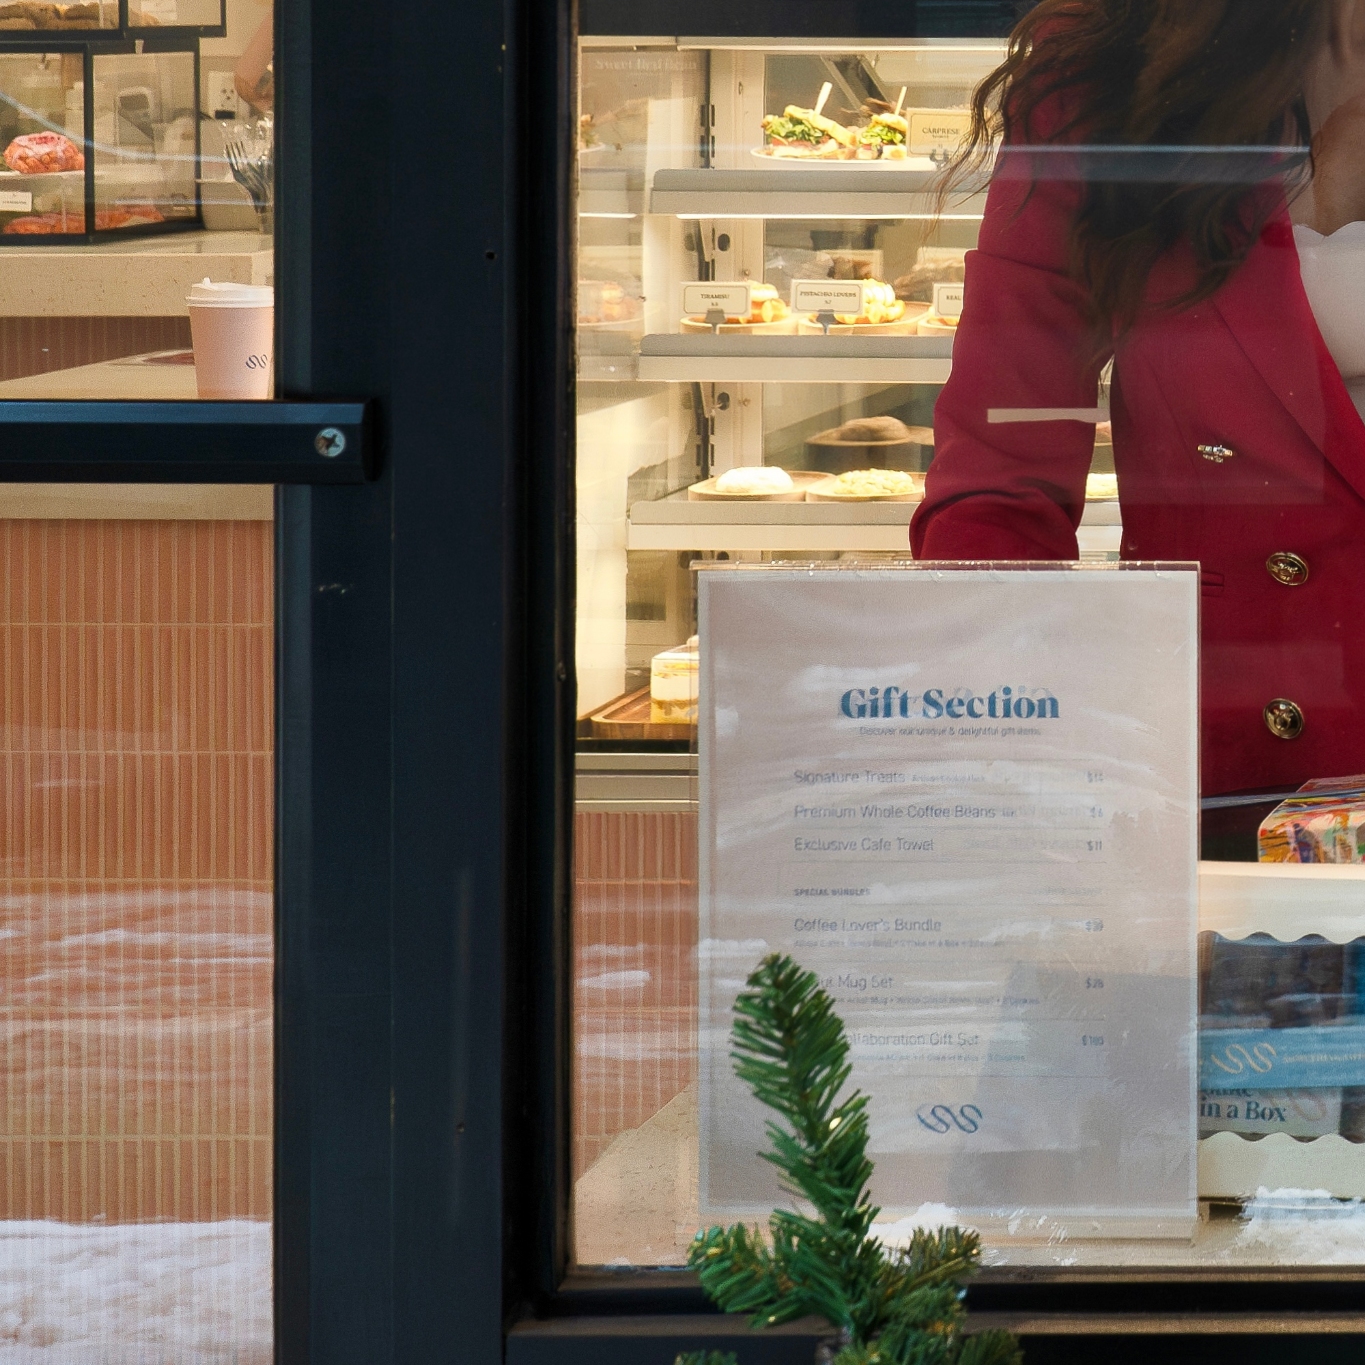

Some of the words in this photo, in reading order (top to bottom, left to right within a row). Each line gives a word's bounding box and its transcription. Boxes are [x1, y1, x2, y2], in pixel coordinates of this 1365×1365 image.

[841, 685, 909, 719] Gift
[922, 685, 1059, 719] Section
[859, 727, 897, 735] Discover
[958, 726, 998, 737] delightful
[1001, 726, 1015, 737] gift
[794, 770, 859, 785] Signature
[864, 770, 905, 783] Treats
[794, 805, 857, 819] Premium
[860, 805, 904, 819] Whole
[907, 805, 950, 819] Coffee
[954, 805, 996, 819] Beans
[794, 838, 858, 851] Exclusive
[861, 837, 892, 851] Cafe
[897, 837, 934, 852] Towel
[794, 888, 829, 896] SPECIAL
[794, 918, 838, 932] Coffee
[842, 918, 890, 932] Lover's
[894, 918, 942, 932] Bundle
[838, 976, 867, 991] Mug
[871, 976, 894, 989] Set
[929, 1033, 953, 1046] Gift
[957, 1033, 979, 1046] Set
[1227, 1105, 1239, 1118] a
[1245, 1101, 1287, 1122] Box
